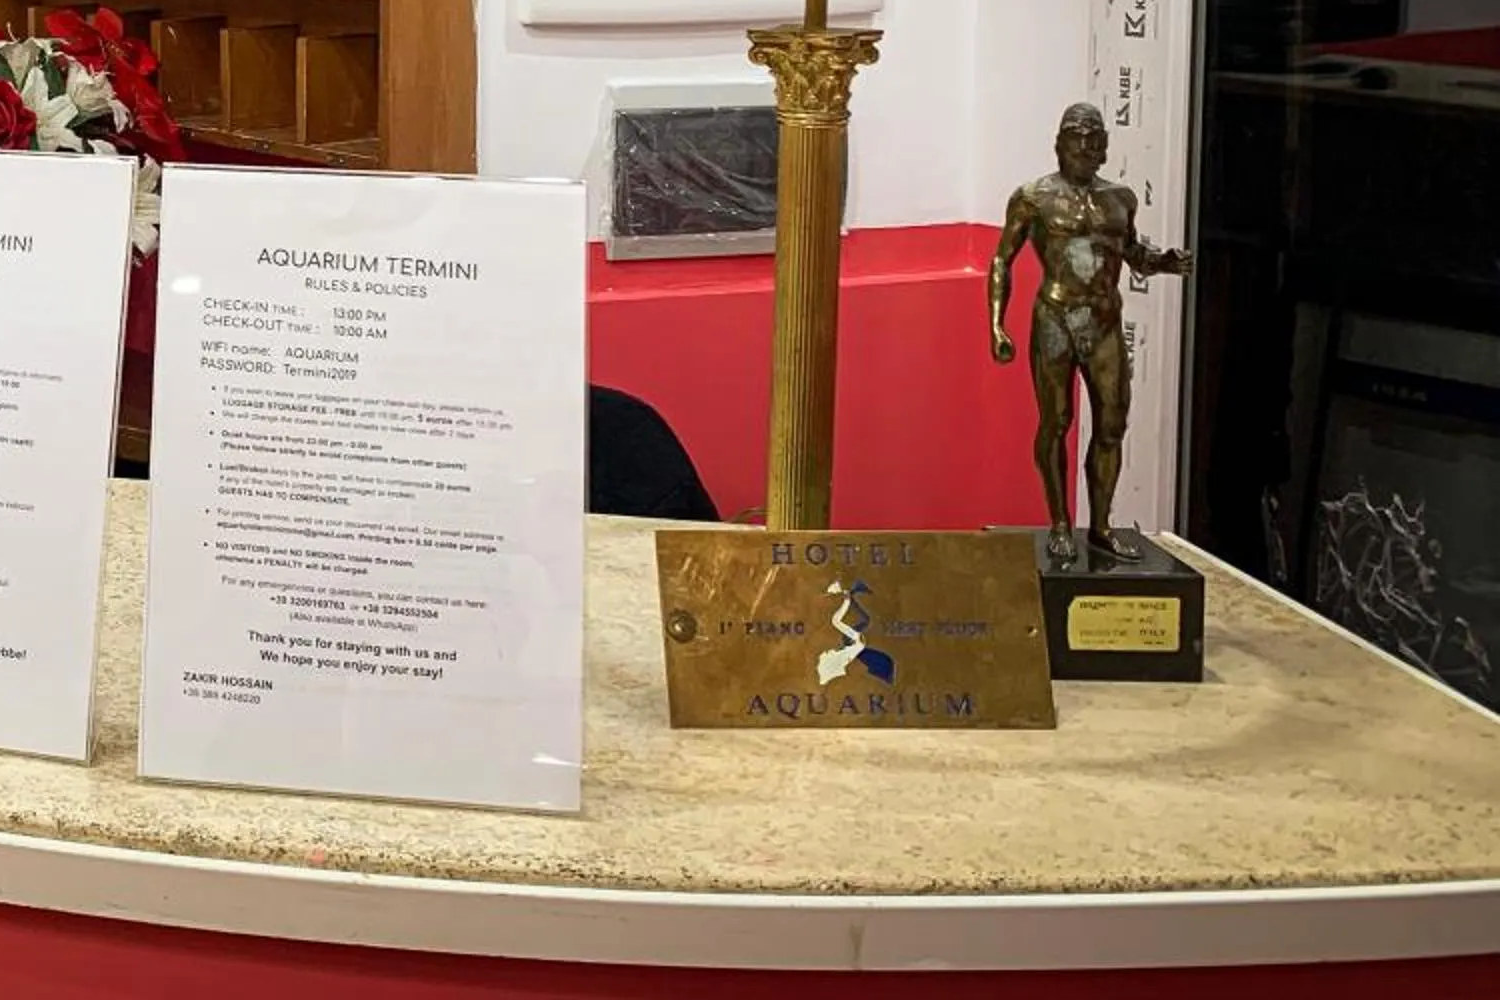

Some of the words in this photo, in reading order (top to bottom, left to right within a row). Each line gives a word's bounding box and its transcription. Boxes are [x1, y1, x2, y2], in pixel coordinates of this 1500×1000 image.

[1119, 66, 1131, 99] KBE
[257, 247, 378, 272] AQUARIUM
[386, 256, 477, 280] TERMINI
[304, 276, 349, 293] RULES
[351, 281, 361, 293] &
[364, 281, 427, 298] POLICIES
[203, 297, 269, 313] CHECK-IN
[332, 307, 362, 321] 13:00
[365, 308, 386, 321] PM
[202, 313, 283, 331] CHECK-OUT
[333, 324, 363, 338] 10:00
[365, 327, 387, 338] AM
[201, 340, 228, 352] WIFI
[285, 346, 358, 363] AQUARIUM
[200, 356, 274, 374] PASSWORD:
[282, 362, 357, 380] Termini2019
[263, 557, 302, 568] PENALTY
[771, 543, 917, 566] HOTEL
[249, 630, 285, 644] Thank
[288, 637, 312, 648] you
[315, 637, 332, 649] for
[335, 640, 381, 657] staying
[384, 646, 411, 656] with
[414, 649, 429, 659] us
[433, 651, 457, 661] and
[259, 649, 279, 662] We
[282, 652, 313, 666] hope
[316, 658, 340, 669] you
[342, 659, 377, 674] enjoy
[380, 664, 409, 675] your
[412, 667, 443, 680] stay!
[182, 671, 217, 683] ZAKIR
[220, 675, 272, 690] HOSSAIN
[745, 693, 975, 719] AQUARIUM
